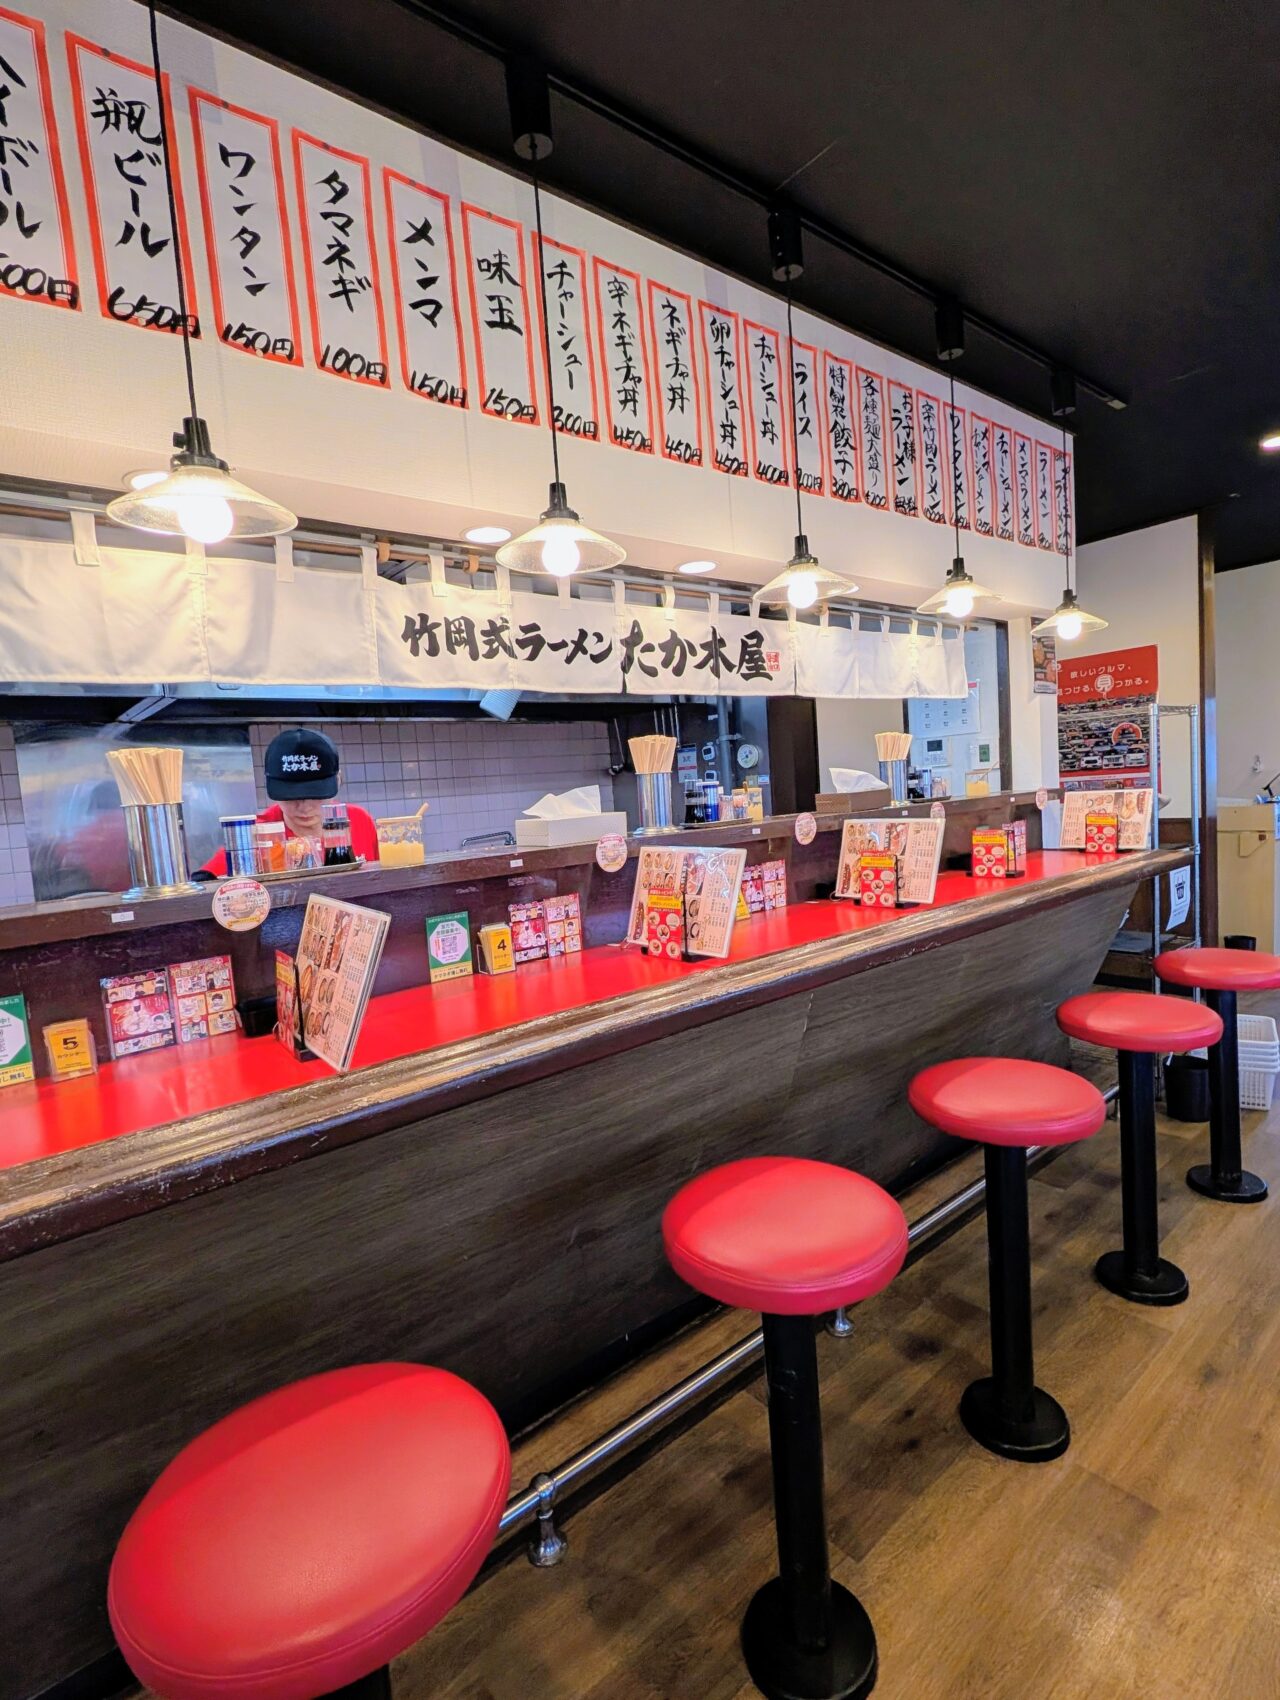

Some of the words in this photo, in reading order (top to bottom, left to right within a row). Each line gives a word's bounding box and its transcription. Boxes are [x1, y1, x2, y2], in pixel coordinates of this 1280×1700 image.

[90, 86, 171, 259] 瓶ビール
[217, 142, 271, 297] ワンタン
[314, 168, 373, 313] タマネギ
[0, 262, 80, 310] 00円
[402, 216, 444, 328] メンマ
[476, 248, 524, 336] 味玉
[107, 286, 200, 338] 650円
[221, 322, 296, 361] 150円
[546, 259, 583, 390] チャーシュー
[320, 343, 388, 385] 100円
[409, 370, 468, 409] 150円
[661, 297, 691, 416] ネギチャ丼
[709, 315, 740, 450] 卵チャーシュー丼
[753, 333, 780, 446] チャーシュー丼
[482, 387, 537, 423] 150円
[551, 405, 599, 441] 300円
[794, 361, 813, 439] ライス
[828, 364, 859, 476] 特製餃子
[902, 391, 917, 465] お子様
[613, 424, 653, 452] 450円
[665, 434, 703, 464] 450円
[714, 448, 749, 477] 450円
[756, 459, 790, 486] 400円
[891, 408, 911, 487] ラーメン
[996, 432, 1013, 527] チャーシューメン
[1018, 441, 1033, 533] メンマラーメン
[1039, 451, 1051, 518] ラーメン
[400, 612, 613, 664] 竹岡式ラーメン
[619, 619, 774, 682] たか木屋
[497, 938, 507, 951] 4
[62, 1036, 79, 1051] 5
